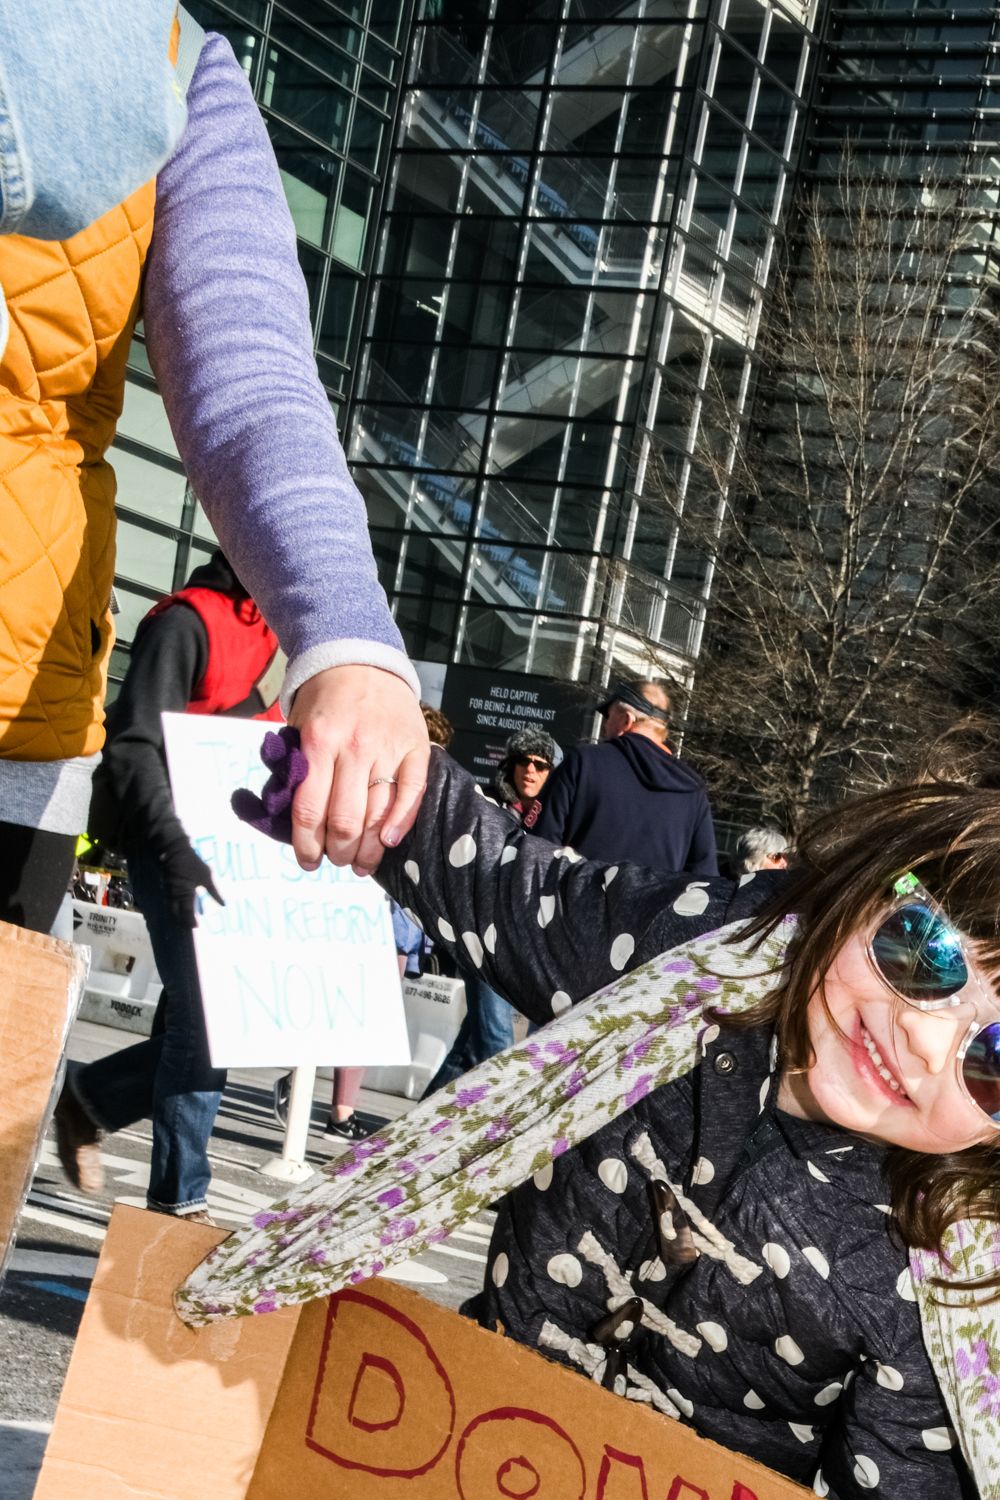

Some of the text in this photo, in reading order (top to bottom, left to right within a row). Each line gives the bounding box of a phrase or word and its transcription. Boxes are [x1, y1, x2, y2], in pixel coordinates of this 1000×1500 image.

[490, 687, 540, 704] HELD CAPTIVE
[469, 698, 557, 720] FOR BEING A JOURNALIST
[476, 714, 498, 727] SINCE
[498, 717, 527, 731] AUGUST
[193, 834, 271, 883] FULL
[89, 912, 118, 925] TRINITY
[283, 894, 389, 947] REFORM
[232, 959, 367, 1037] NOW
